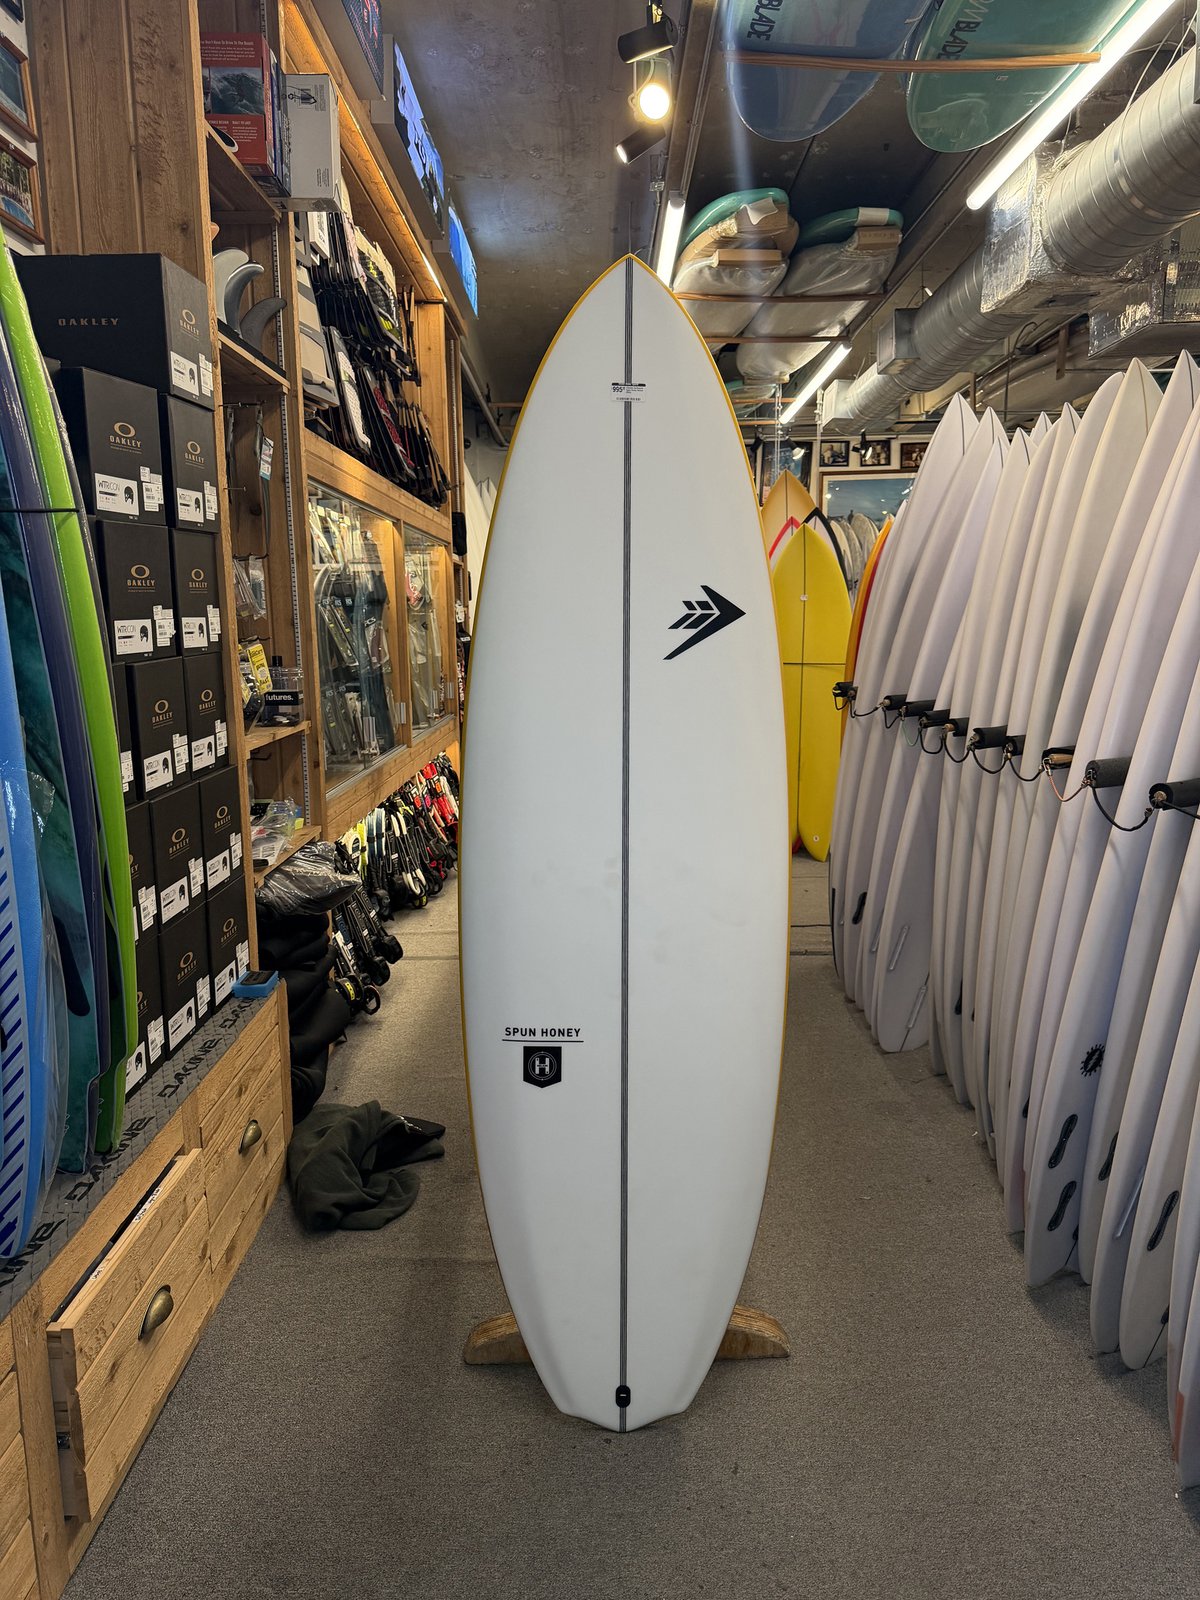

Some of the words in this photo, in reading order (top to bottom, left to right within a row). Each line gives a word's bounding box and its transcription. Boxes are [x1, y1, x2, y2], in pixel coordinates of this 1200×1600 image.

[58, 318, 119, 327] OAKLEY
[179, 319, 200, 336] OAKLEY
[109, 435, 142, 448] OAKLEY
[184, 452, 205, 464] OAKLEY
[127, 579, 156, 587] OAKLEY
[198, 700, 217, 710] OAKLEY
[151, 711, 173, 723] OAKLEY
[214, 815, 231, 829] OAKLEY
[168, 837, 190, 854] OAKLEY
[176, 960, 198, 980] OAKLEY
[505, 1027, 536, 1037] SPUN
[541, 1028, 581, 1037] HONEY
